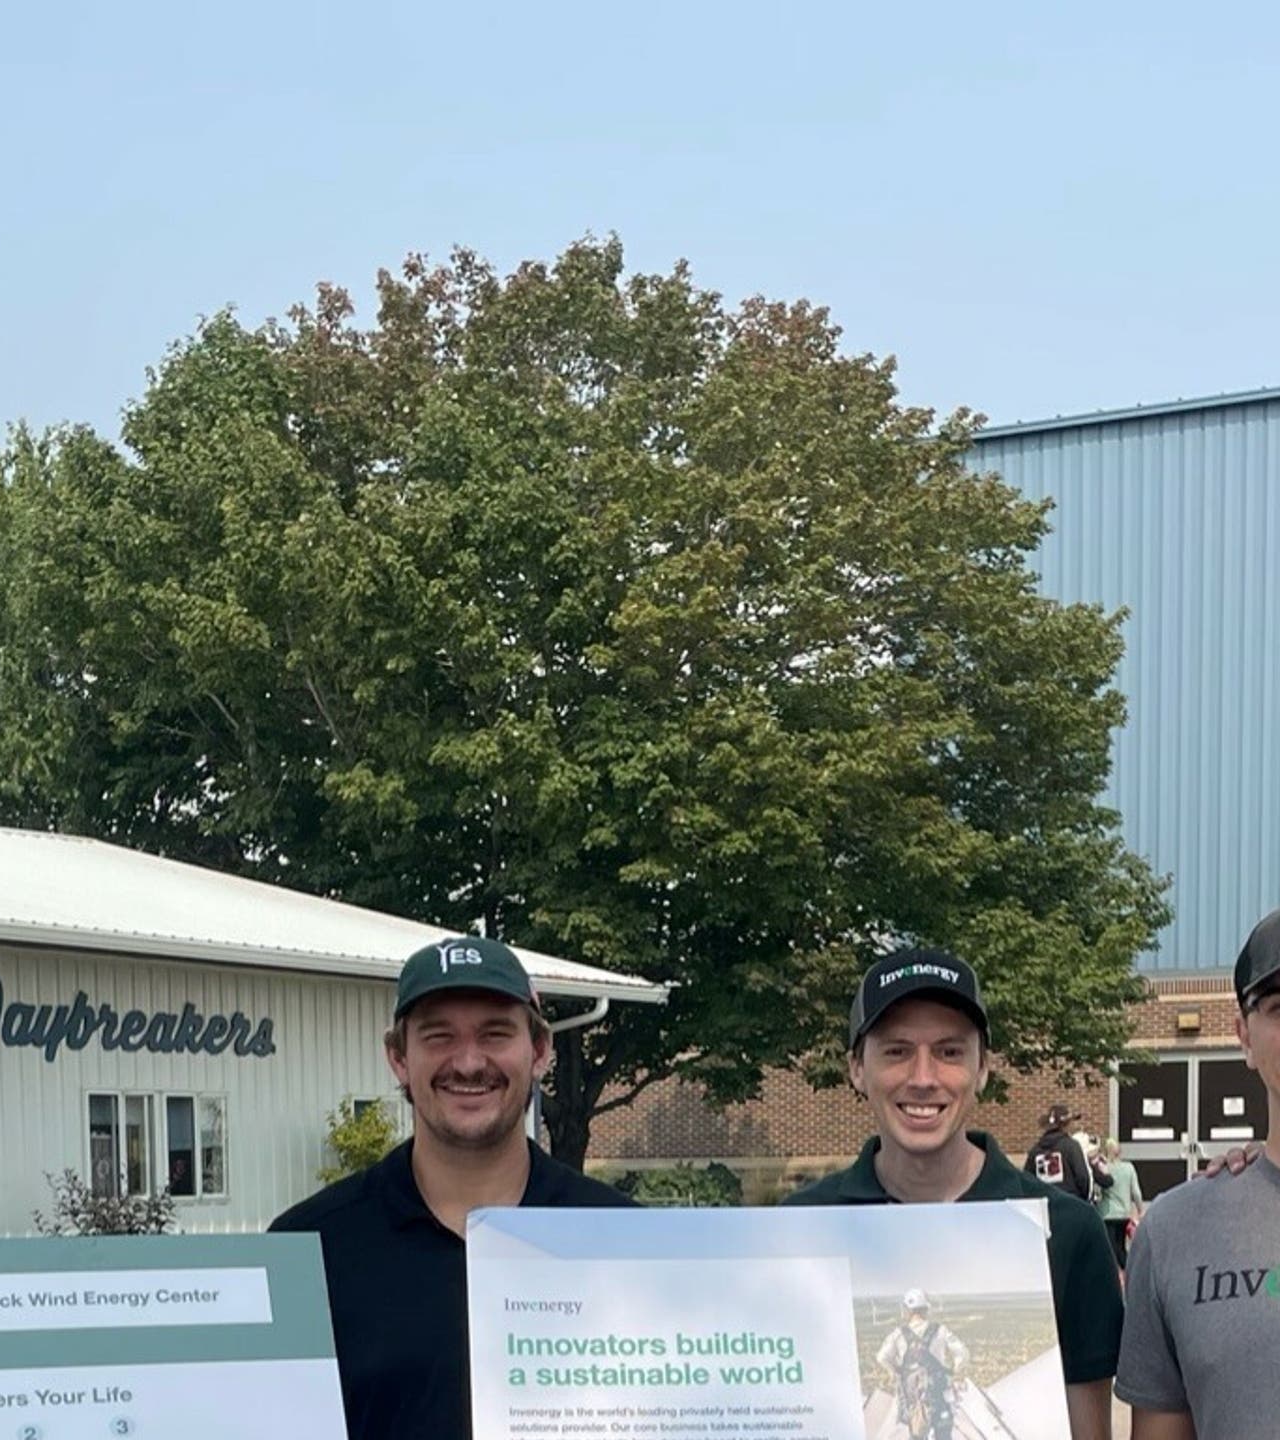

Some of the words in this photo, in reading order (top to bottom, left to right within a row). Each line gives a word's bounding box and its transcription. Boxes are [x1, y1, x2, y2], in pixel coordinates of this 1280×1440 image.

[879, 963, 960, 988] Invenergy
[28, 1291, 78, 1307] Wind
[83, 1289, 150, 1307] Energy
[155, 1288, 220, 1304] Center
[504, 1297, 583, 1315] Invenergy
[507, 1333, 667, 1357] Innovators
[676, 1332, 795, 1360] building
[508, 1367, 526, 1386] a
[536, 1362, 710, 1386] sustainable
[719, 1361, 804, 1386] world
[35, 1389, 86, 1407] Your
[93, 1386, 133, 1404] Life
[116, 1420, 129, 1434] 3
